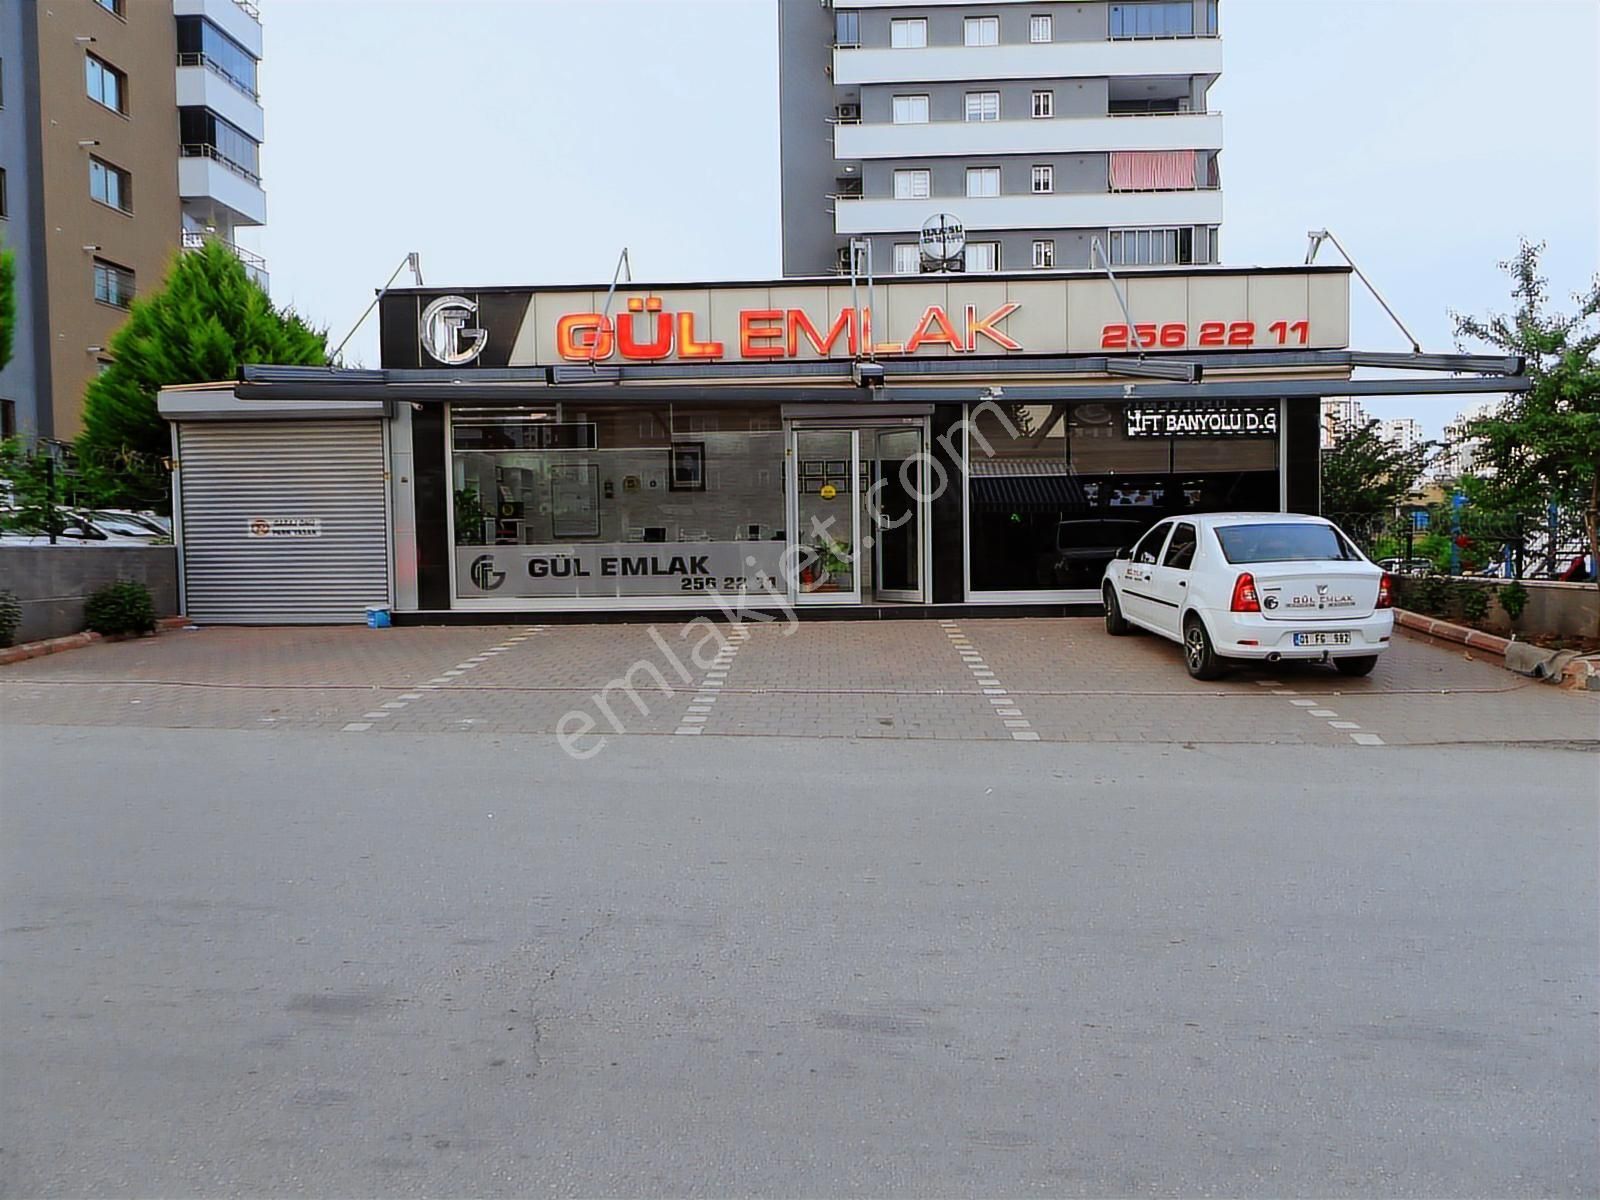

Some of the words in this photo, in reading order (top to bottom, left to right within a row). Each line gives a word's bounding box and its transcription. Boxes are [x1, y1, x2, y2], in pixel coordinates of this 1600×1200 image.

[556, 297, 724, 361] GÜL
[739, 303, 1023, 357] EMLAK
[1101, 323, 1188, 349] 256
[1199, 320, 1256, 346] 22
[1268, 319, 1310, 345] 11
[1166, 413, 1241, 431] BANYOLU
[528, 554, 590, 577] GÜL
[601, 556, 709, 576] EMLAK
[681, 577, 716, 590] 256
